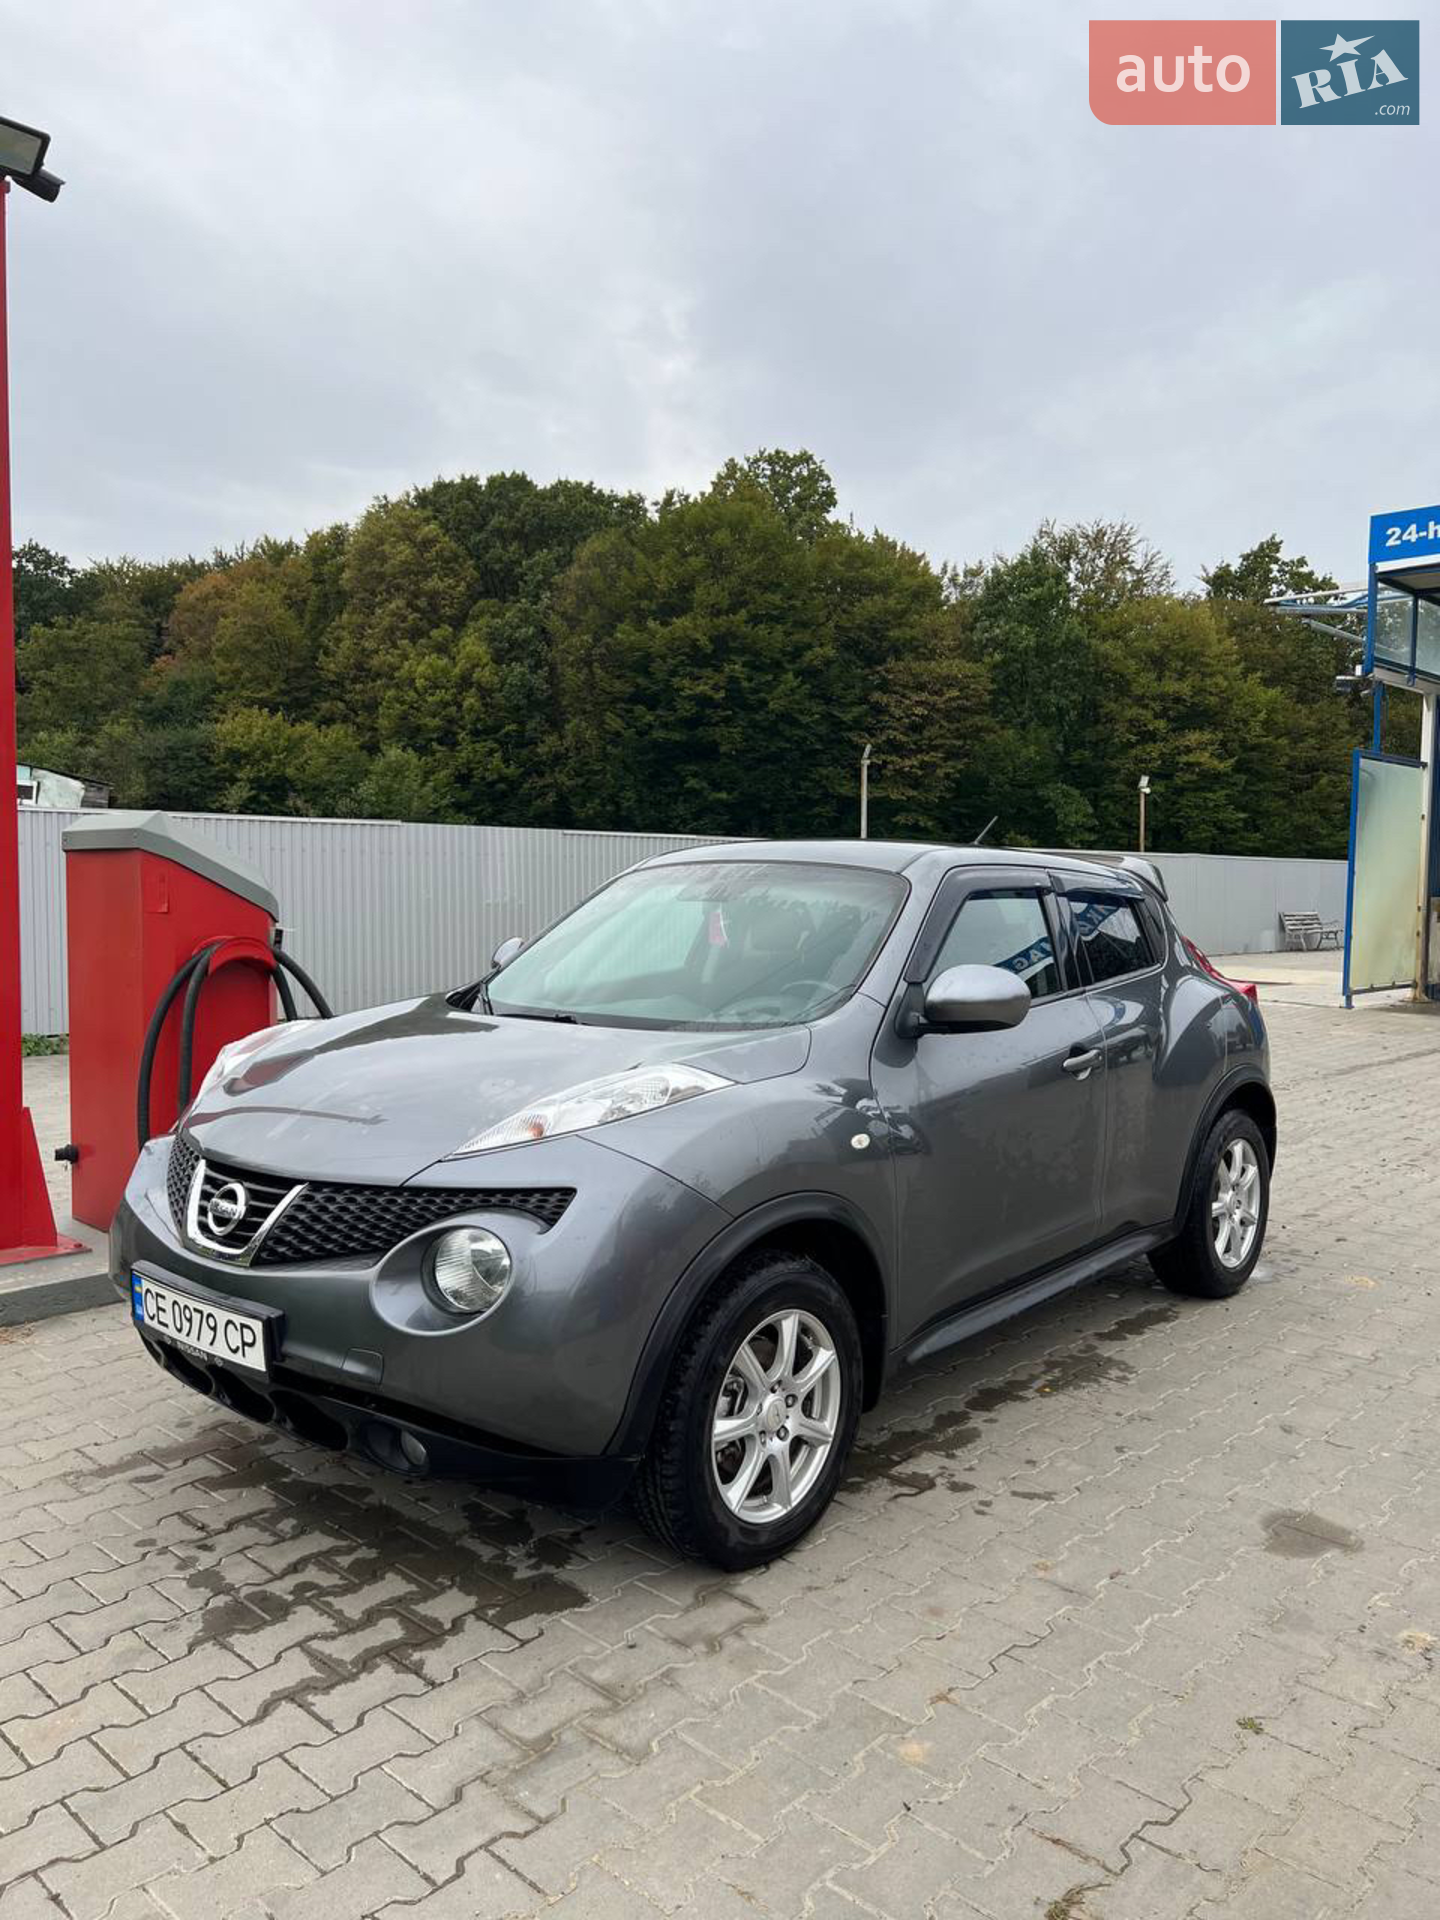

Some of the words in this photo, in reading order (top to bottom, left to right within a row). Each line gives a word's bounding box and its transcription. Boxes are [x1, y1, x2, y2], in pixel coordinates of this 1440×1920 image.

[144, 1288, 169, 1329] CE
[172, 1300, 218, 1346] 0979
[224, 1319, 257, 1358] CP
